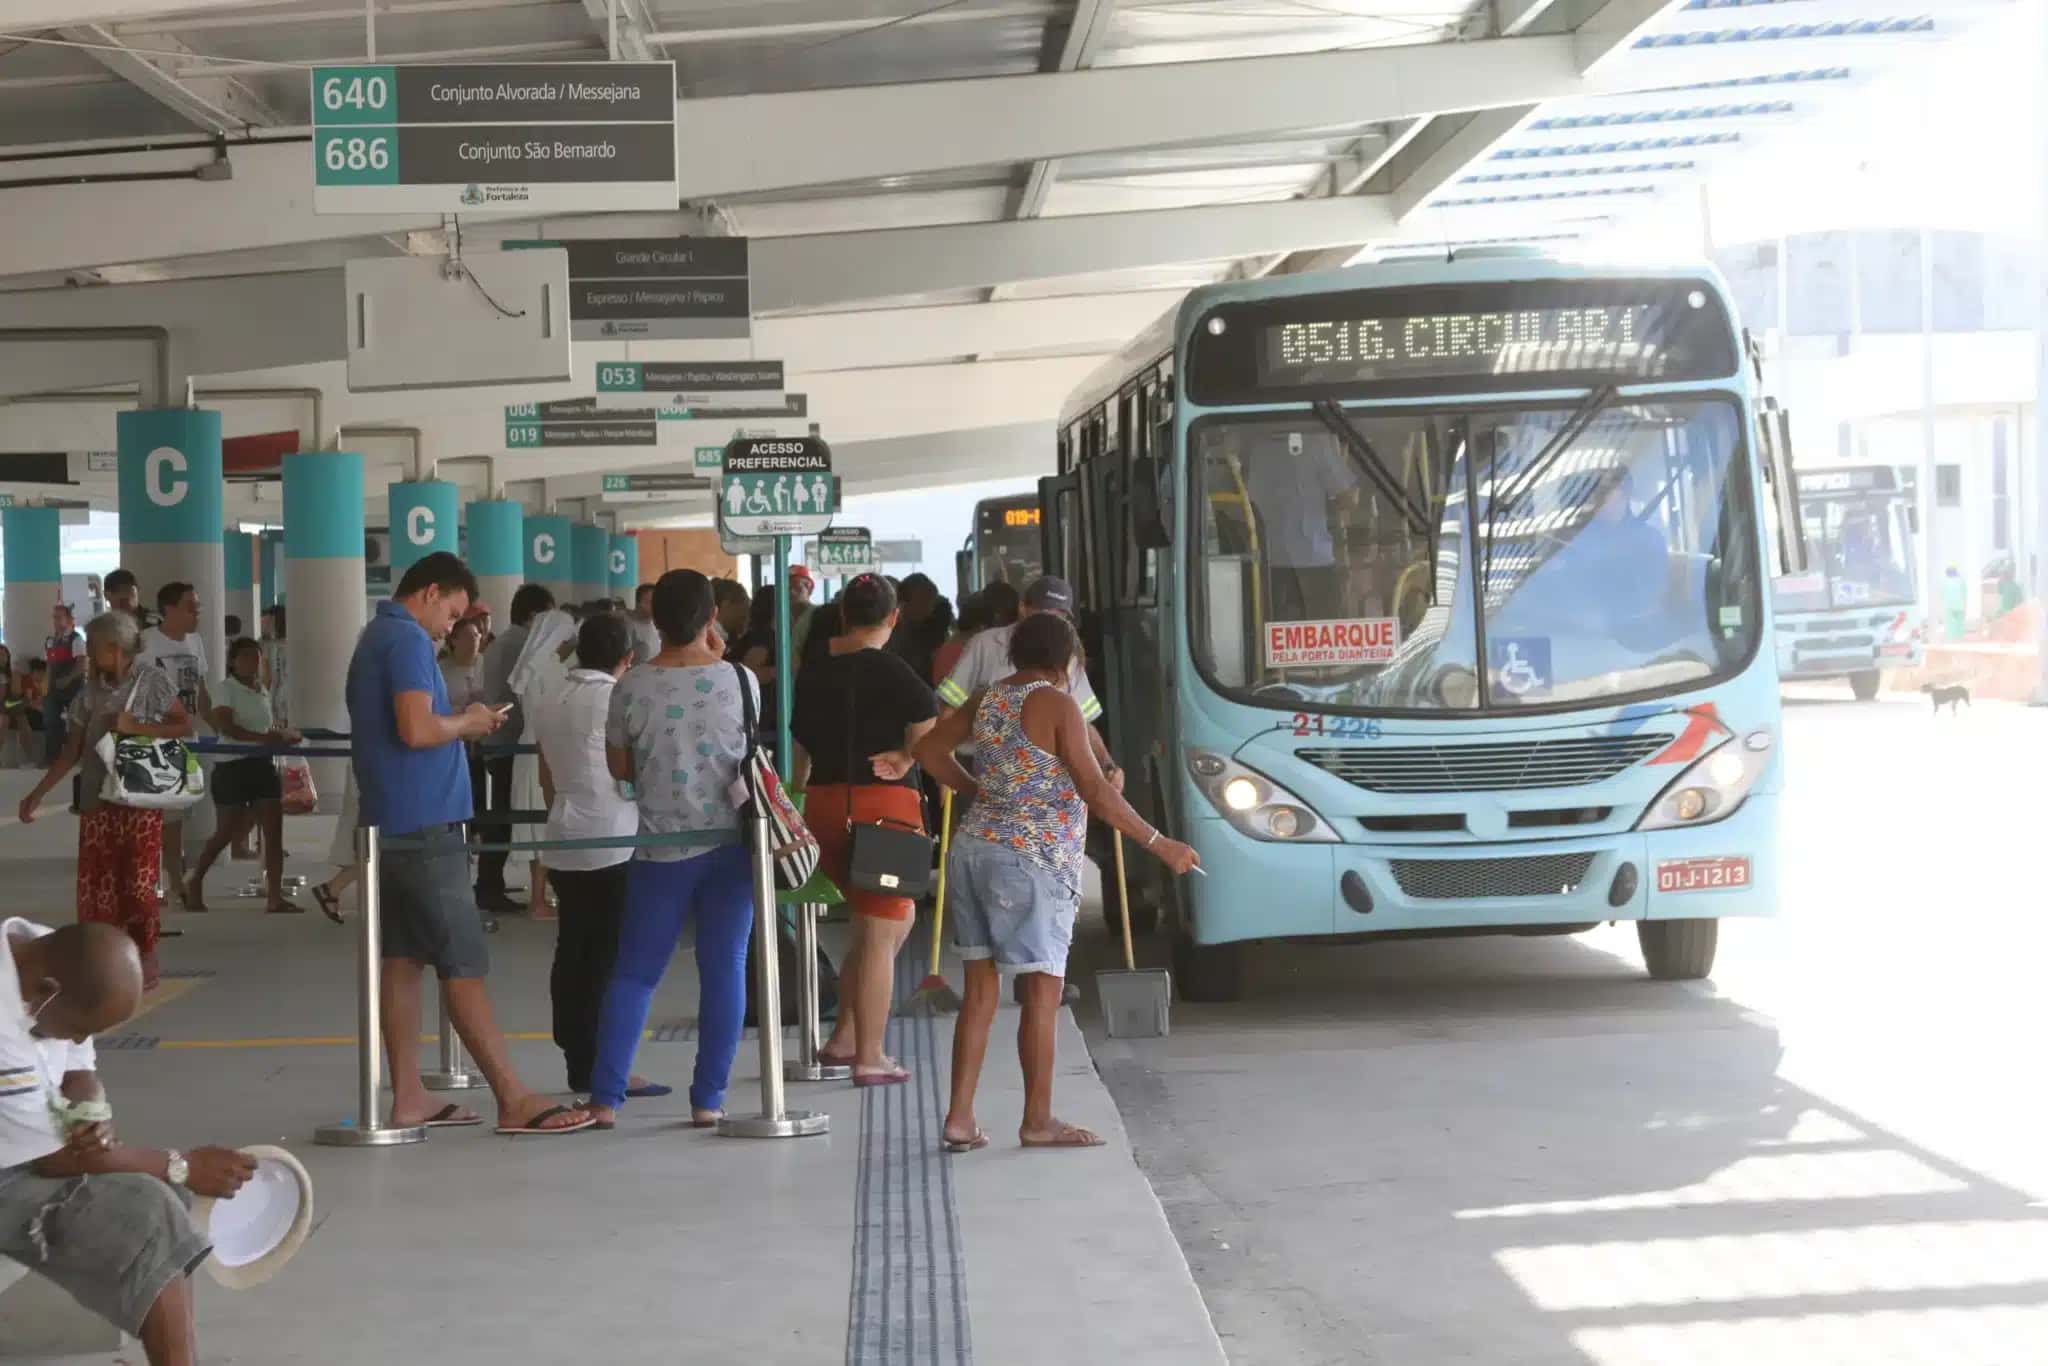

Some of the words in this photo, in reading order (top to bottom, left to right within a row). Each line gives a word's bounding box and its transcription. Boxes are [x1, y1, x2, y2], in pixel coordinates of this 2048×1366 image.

[322, 76, 388, 110] 640
[430, 84, 493, 105] Conjunto
[496, 82, 556, 101] Alvorada
[560, 83, 565, 101] /
[568, 83, 640, 104] Messejana
[324, 138, 389, 171] 686
[459, 142, 521, 164] Conjunto
[524, 141, 550, 159] São
[554, 141, 616, 159] Bernardo
[602, 367, 636, 386] 053
[510, 427, 537, 442] 019
[750, 442, 804, 454] ACESSO
[728, 456, 827, 470] PREFERENCIAL
[145, 446, 188, 506] C
[407, 506, 435, 545] C
[533, 533, 555, 564] C
[608, 549, 626, 573] C
[1271, 623, 1393, 650] EMBARQUE
[1272, 651, 1297, 663] PELA
[1300, 650, 1335, 662] PORTA
[1293, 712, 1324, 737] 21
